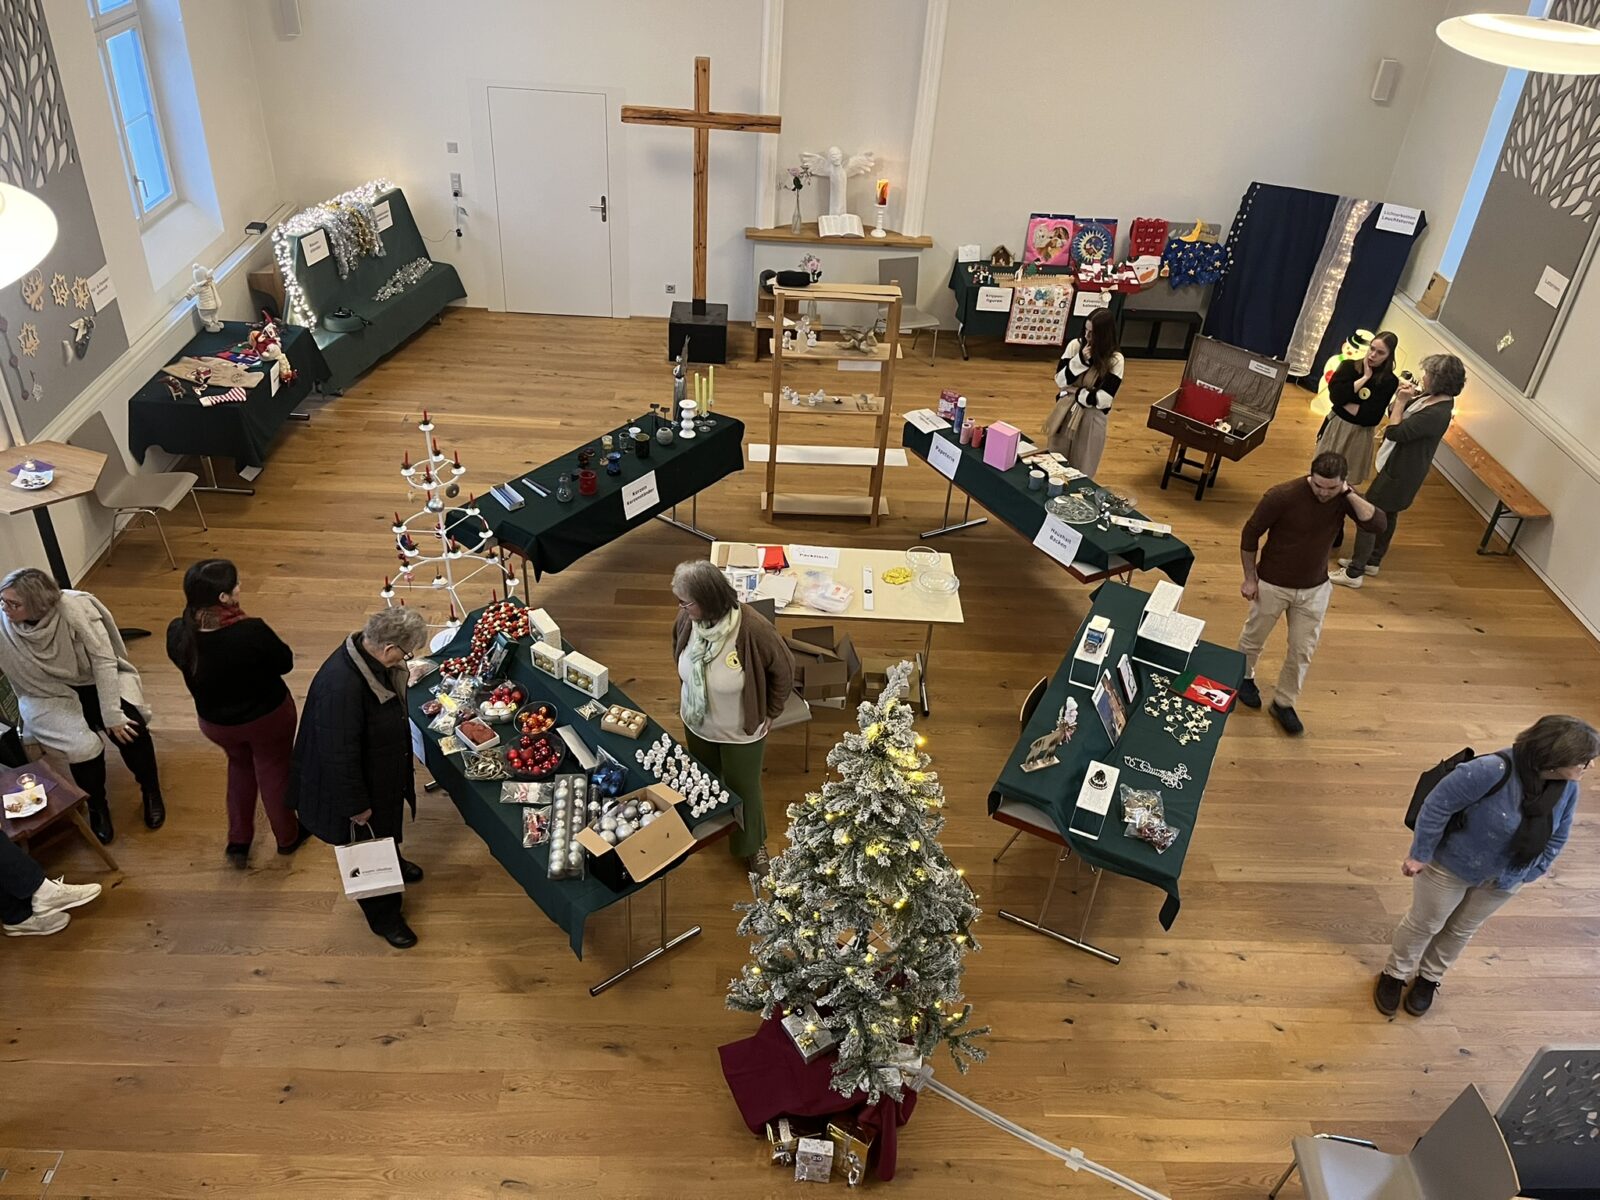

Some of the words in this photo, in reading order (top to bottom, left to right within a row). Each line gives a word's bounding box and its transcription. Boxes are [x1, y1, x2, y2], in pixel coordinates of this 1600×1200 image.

[935, 445, 955, 463] Papeterie
[632, 485, 648, 496] Kerzen
[1049, 534, 1067, 550] Backen
[1050, 528, 1072, 545] Haushalt
[796, 1008, 803, 1016] 3
